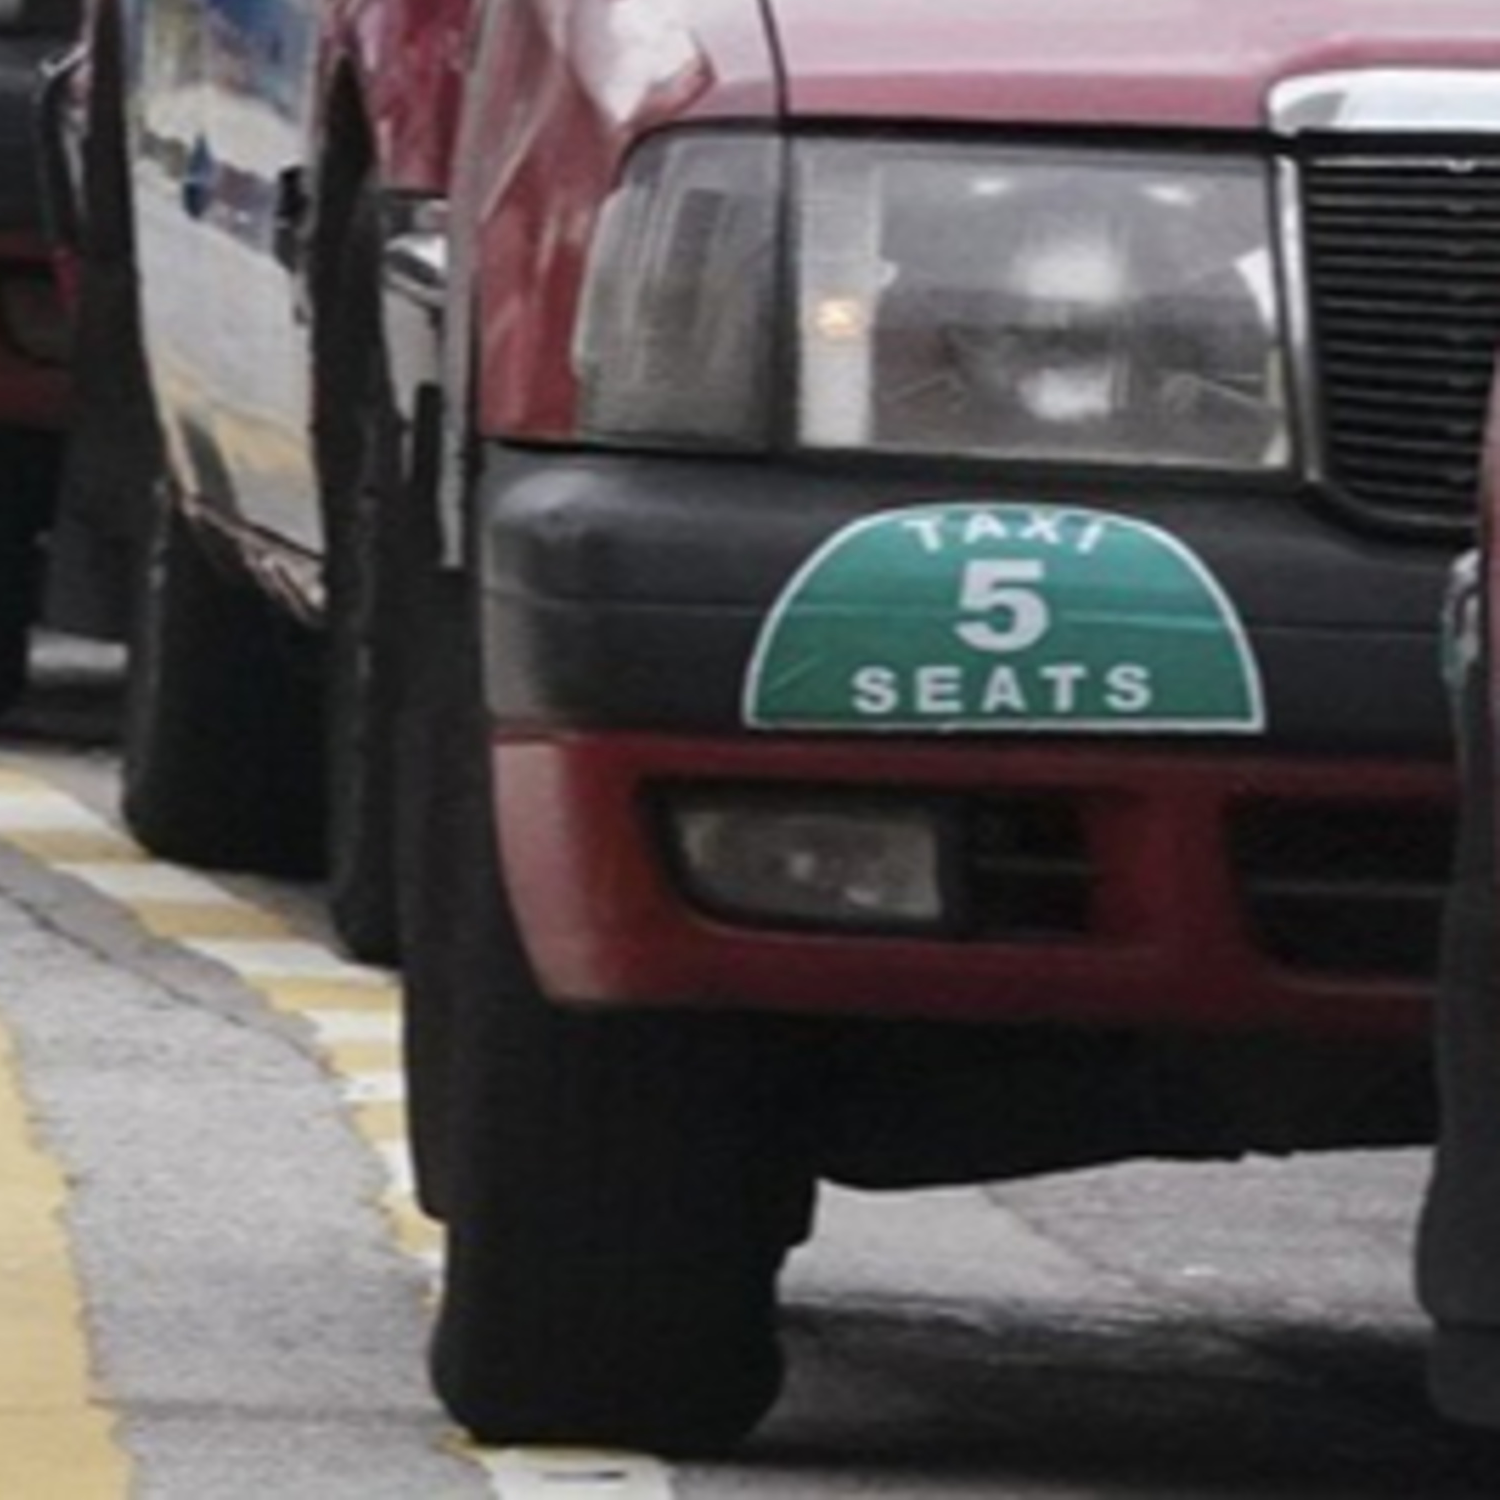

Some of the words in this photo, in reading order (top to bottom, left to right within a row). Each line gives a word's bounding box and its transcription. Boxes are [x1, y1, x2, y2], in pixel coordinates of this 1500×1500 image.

[905, 510, 1106, 553] TAXI
[953, 557, 1052, 653] 5
[850, 664, 1152, 714] SEATS
